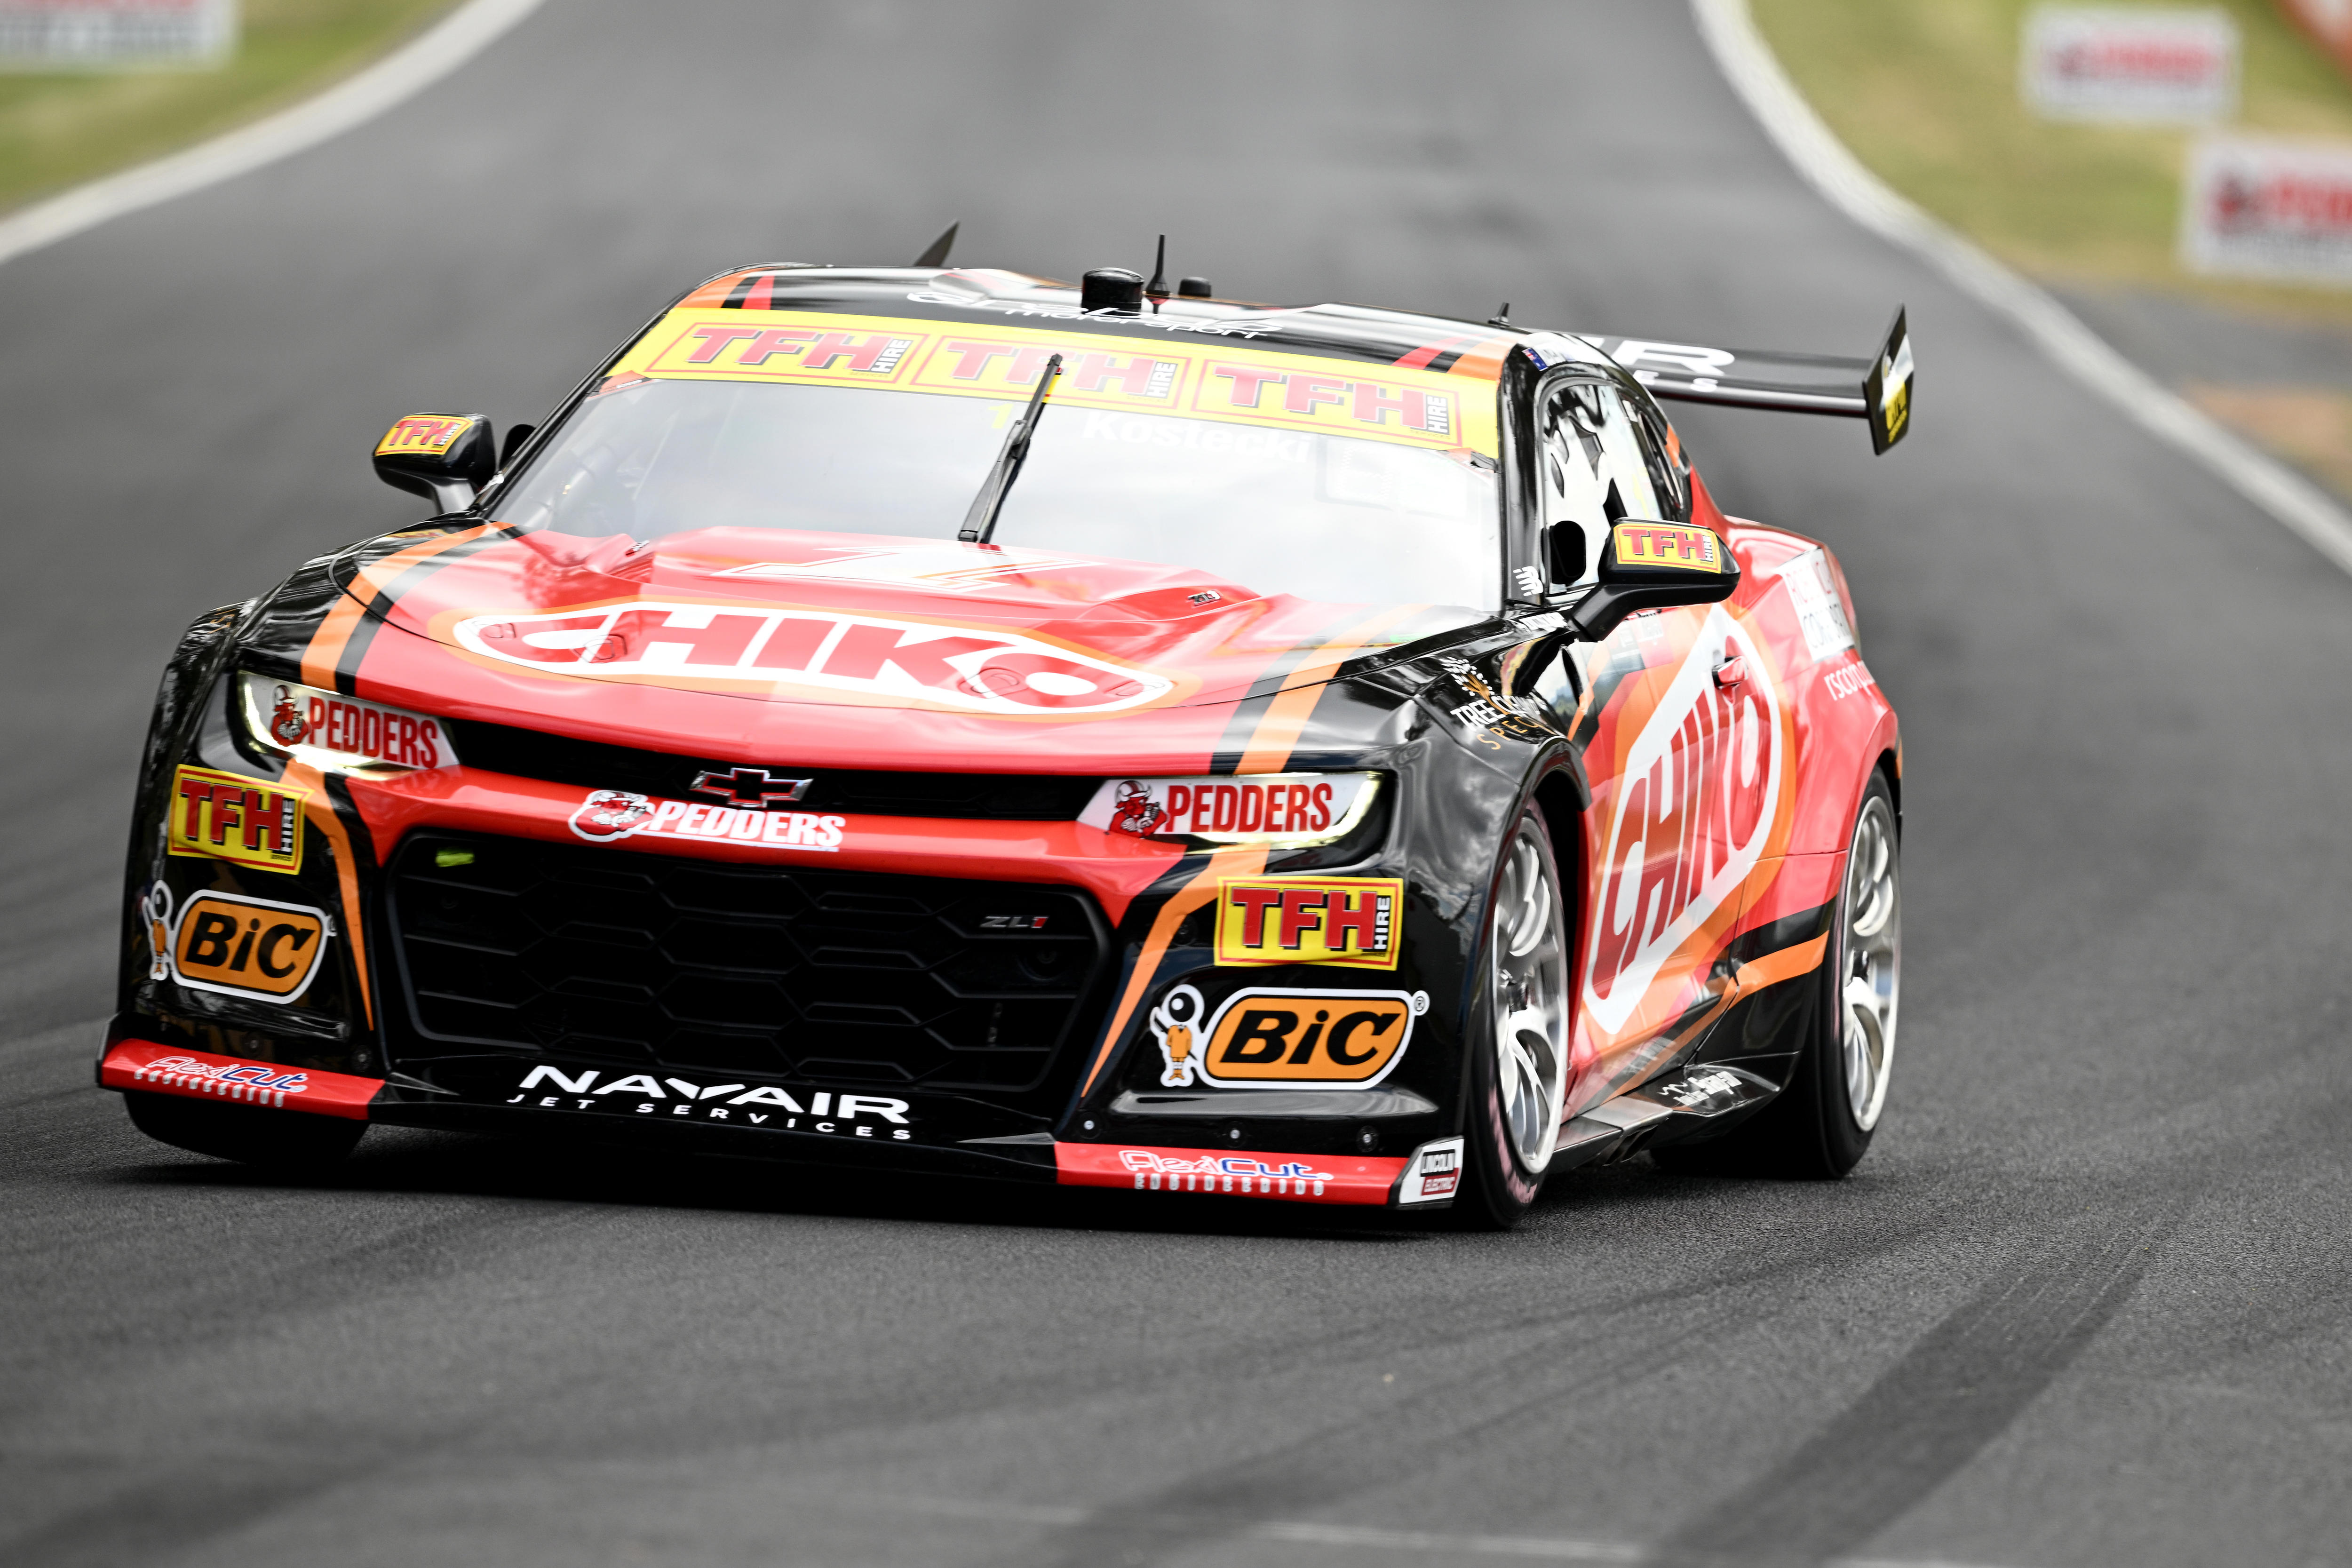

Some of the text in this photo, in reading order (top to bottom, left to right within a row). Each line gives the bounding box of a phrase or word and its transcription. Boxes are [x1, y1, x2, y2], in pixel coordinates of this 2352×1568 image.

[685, 327, 913, 373] TFH HIRE
[1005, 309, 1268, 339] motorsport
[946, 342, 1176, 399] TFH HIRE
[1214, 366, 1449, 435] TFH HIRE
[388, 420, 456, 446] TFH
[1080, 410, 1311, 463] Kostecki
[1621, 528, 1706, 560] TFH
[478, 608, 1145, 708] CHIKO
[308, 696, 438, 769] PEDDERS
[1450, 699, 1507, 732] TREE
[179, 777, 284, 851] TFH
[649, 800, 846, 847] PEDDERS
[1164, 782, 1332, 833] PEDDERS
[1591, 635, 1771, 1001] CHIKO
[184, 911, 316, 979] BiC
[1232, 887, 1391, 950] TFH HIRE
[1219, 1009, 1402, 1066] BiC
[507, 1094, 912, 1140] JET SERVICES
[518, 1065, 910, 1124] NAVAIR
